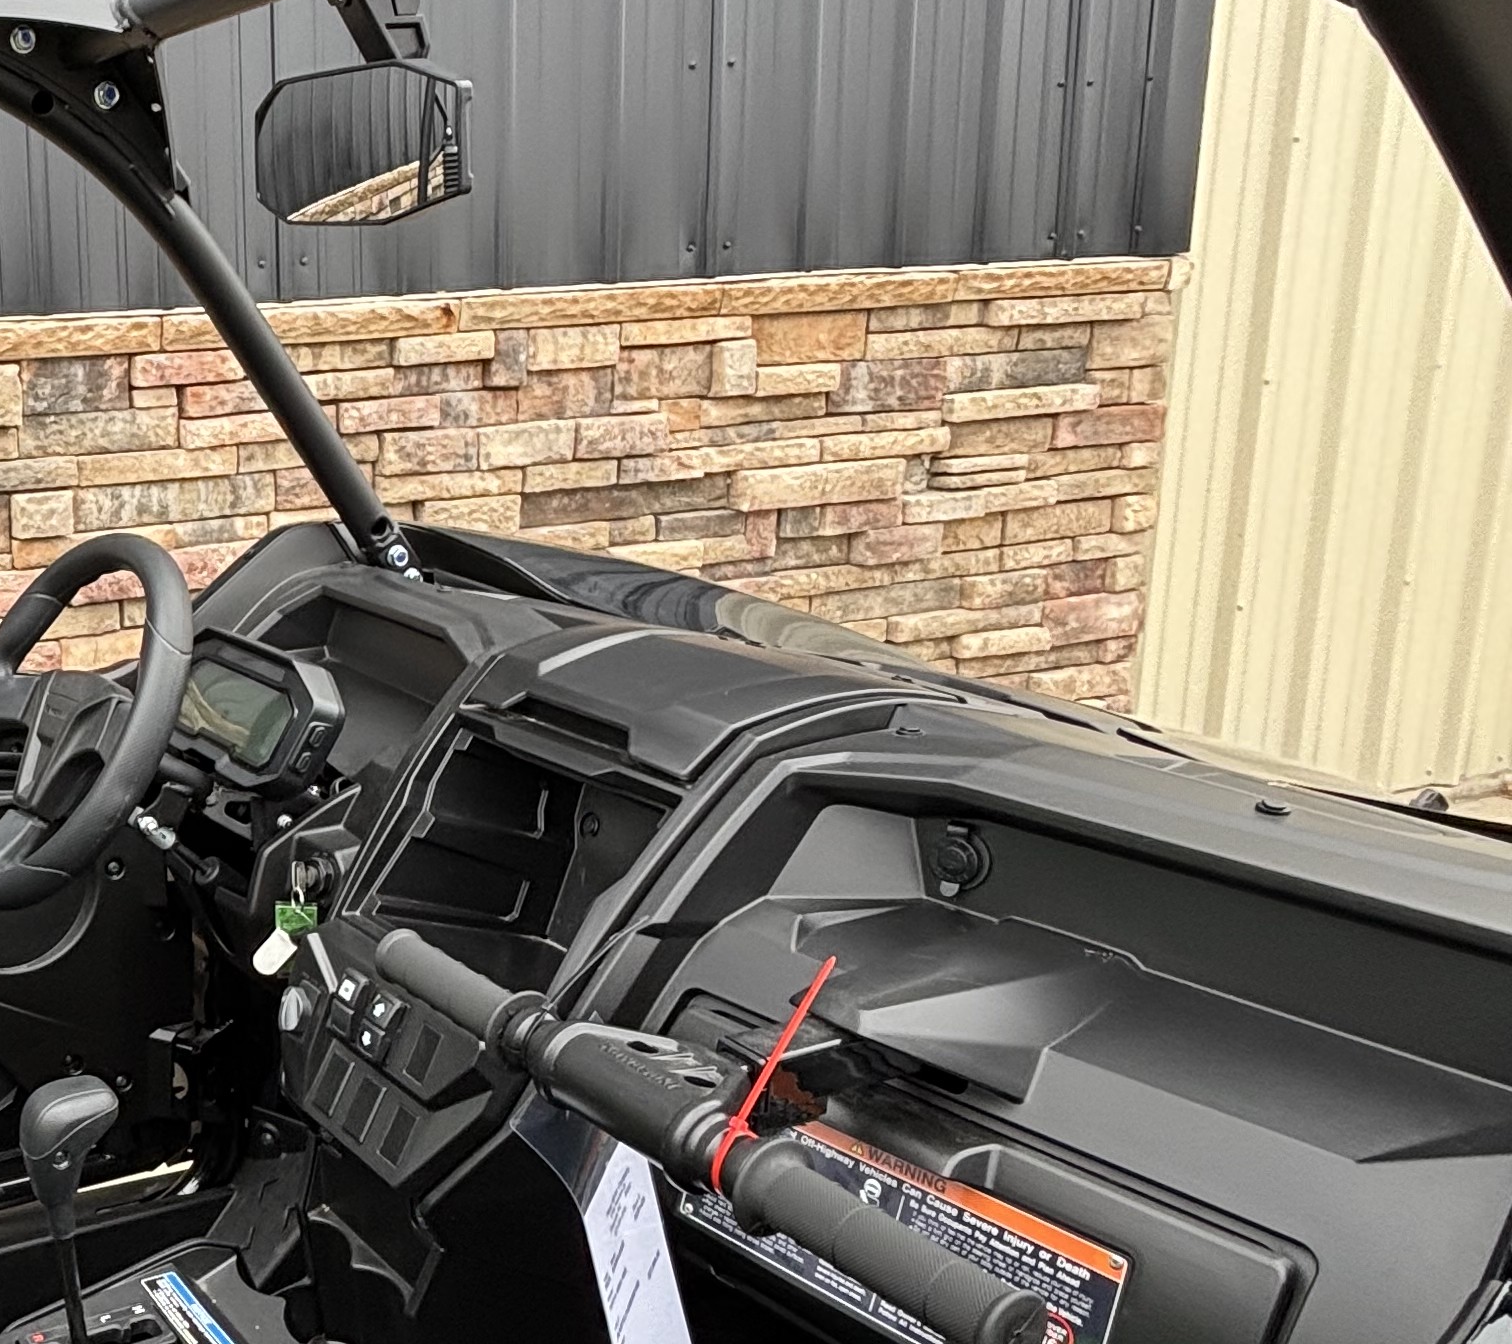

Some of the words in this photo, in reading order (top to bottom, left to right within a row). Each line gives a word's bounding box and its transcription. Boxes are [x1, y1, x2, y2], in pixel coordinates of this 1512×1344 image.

[800, 1135, 855, 1169] Off-Highway
[859, 1161, 898, 1189] Vehicles
[902, 1182, 922, 1200] Can
[926, 1194, 959, 1217] Cause
[962, 1210, 999, 1237] Severe
[1003, 1230, 1035, 1255] Injury
[1039, 1245, 1053, 1262] or
[1056, 1256, 1091, 1281] Death
[868, 1146, 948, 1194] WARNING
